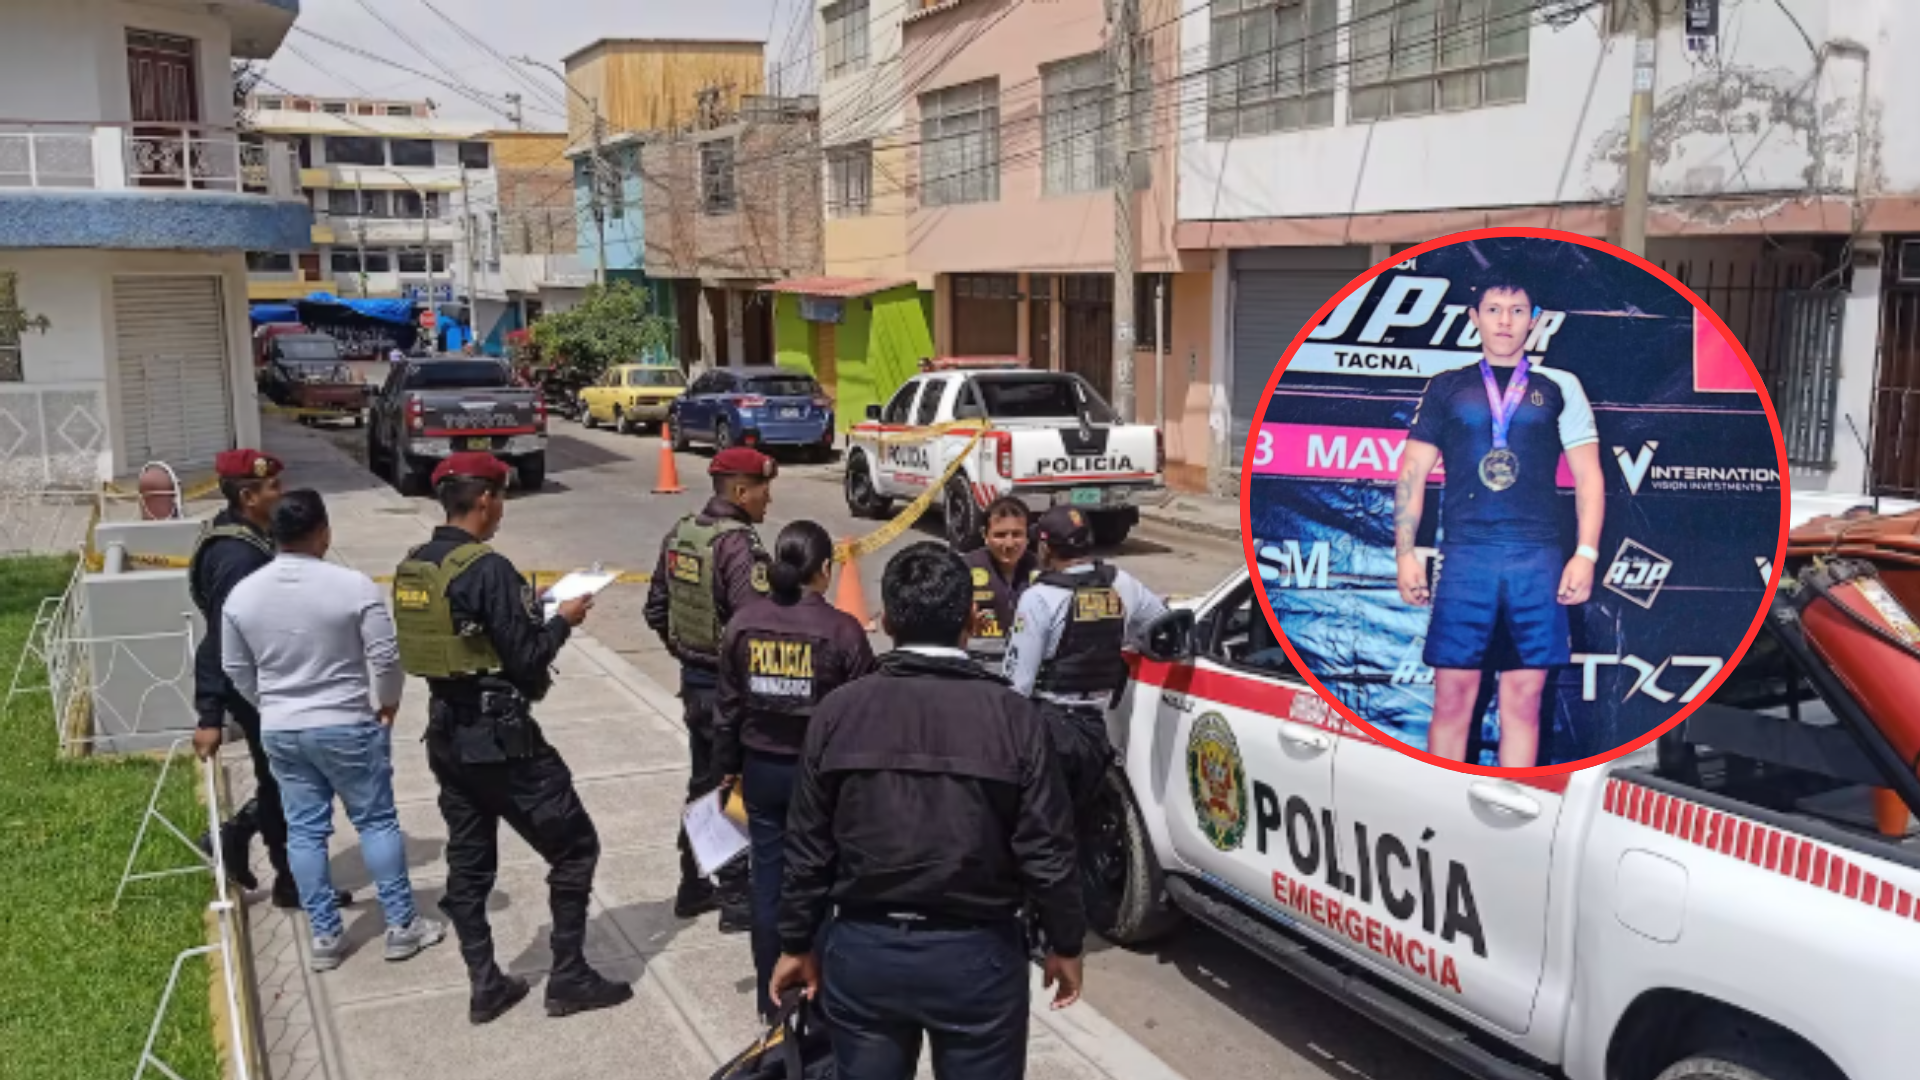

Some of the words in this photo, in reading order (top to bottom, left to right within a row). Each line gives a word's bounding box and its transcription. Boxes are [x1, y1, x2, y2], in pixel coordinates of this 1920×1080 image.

[1334, 351, 1413, 371] TACNA
[1651, 481, 1688, 491] VISION
[1689, 481, 1763, 492] INVESTMENTS
[1609, 561, 1672, 585] AJP
[1570, 653, 1724, 704] TX7
[1252, 778, 1489, 960] POLICÍA
[1271, 869, 1463, 995] EMERGENCIA
